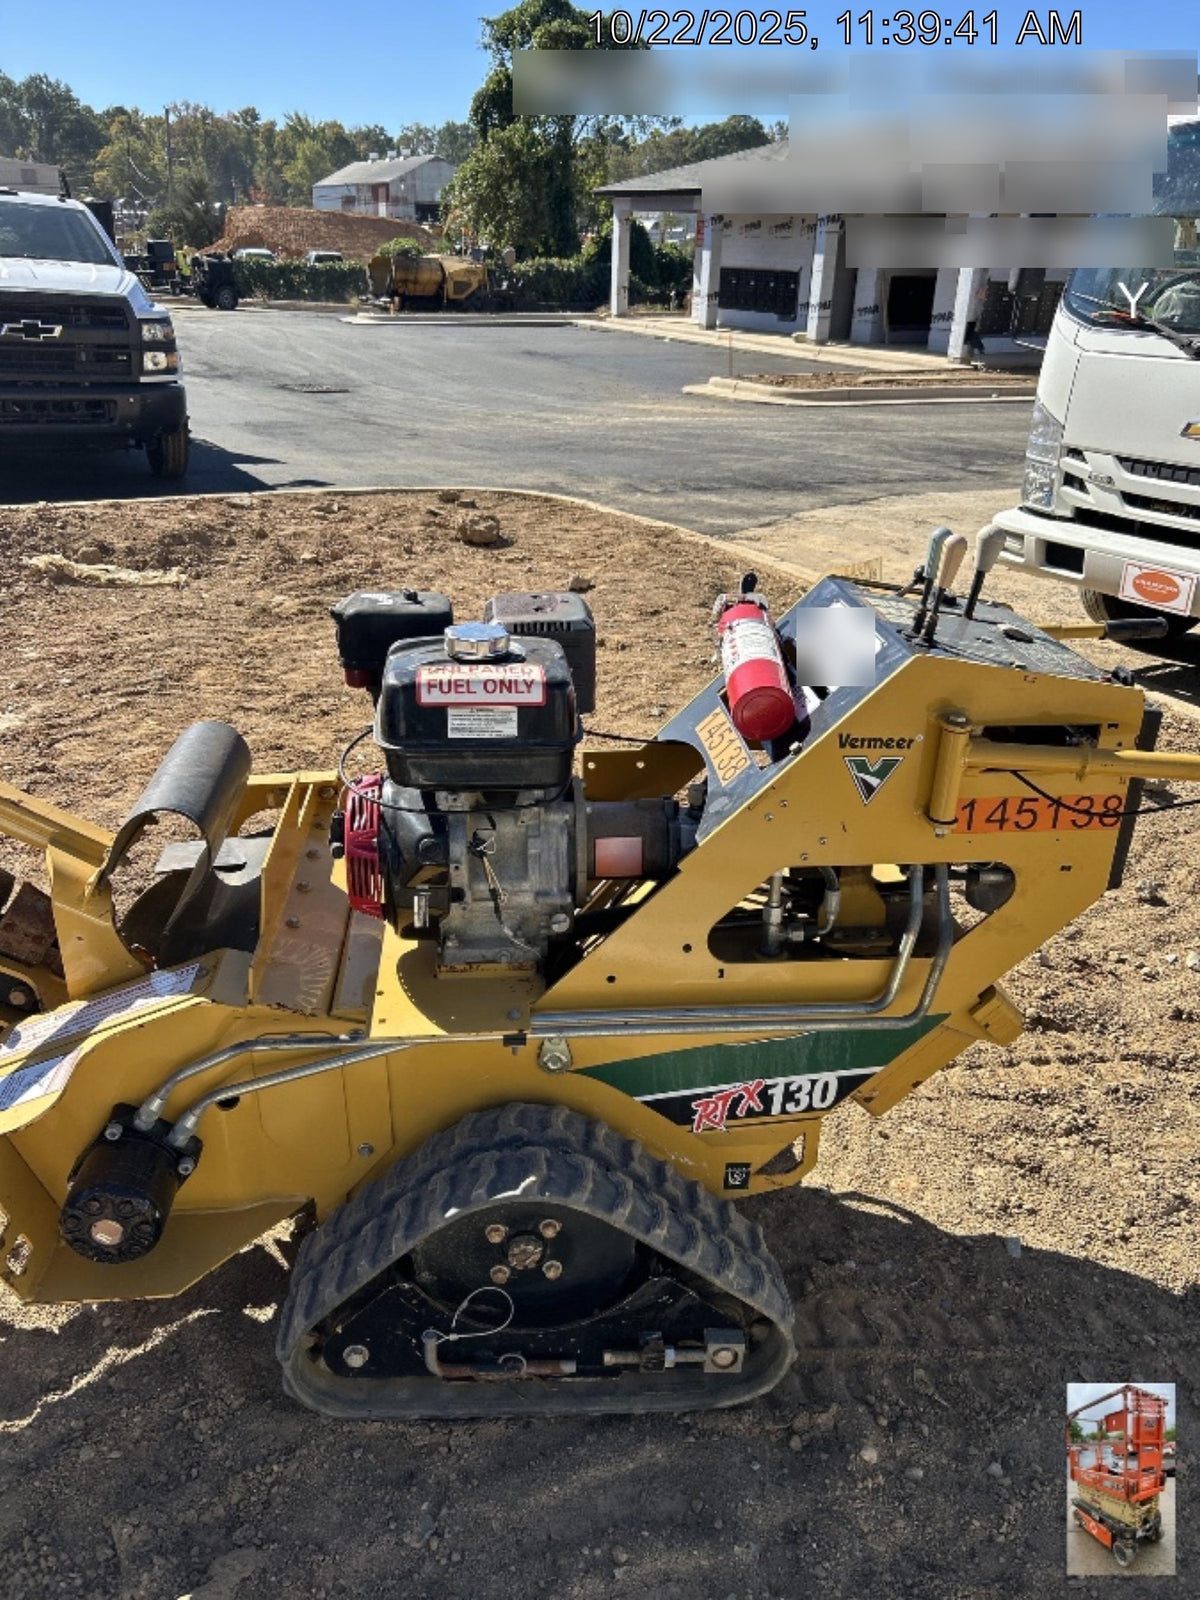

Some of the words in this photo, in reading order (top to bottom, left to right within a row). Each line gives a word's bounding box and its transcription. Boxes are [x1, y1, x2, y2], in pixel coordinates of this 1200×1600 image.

[426, 679, 477, 695] FUEL
[483, 678, 535, 694] ONLY
[838, 733, 914, 749] Vermeer
[960, 794, 1124, 832] 145138
